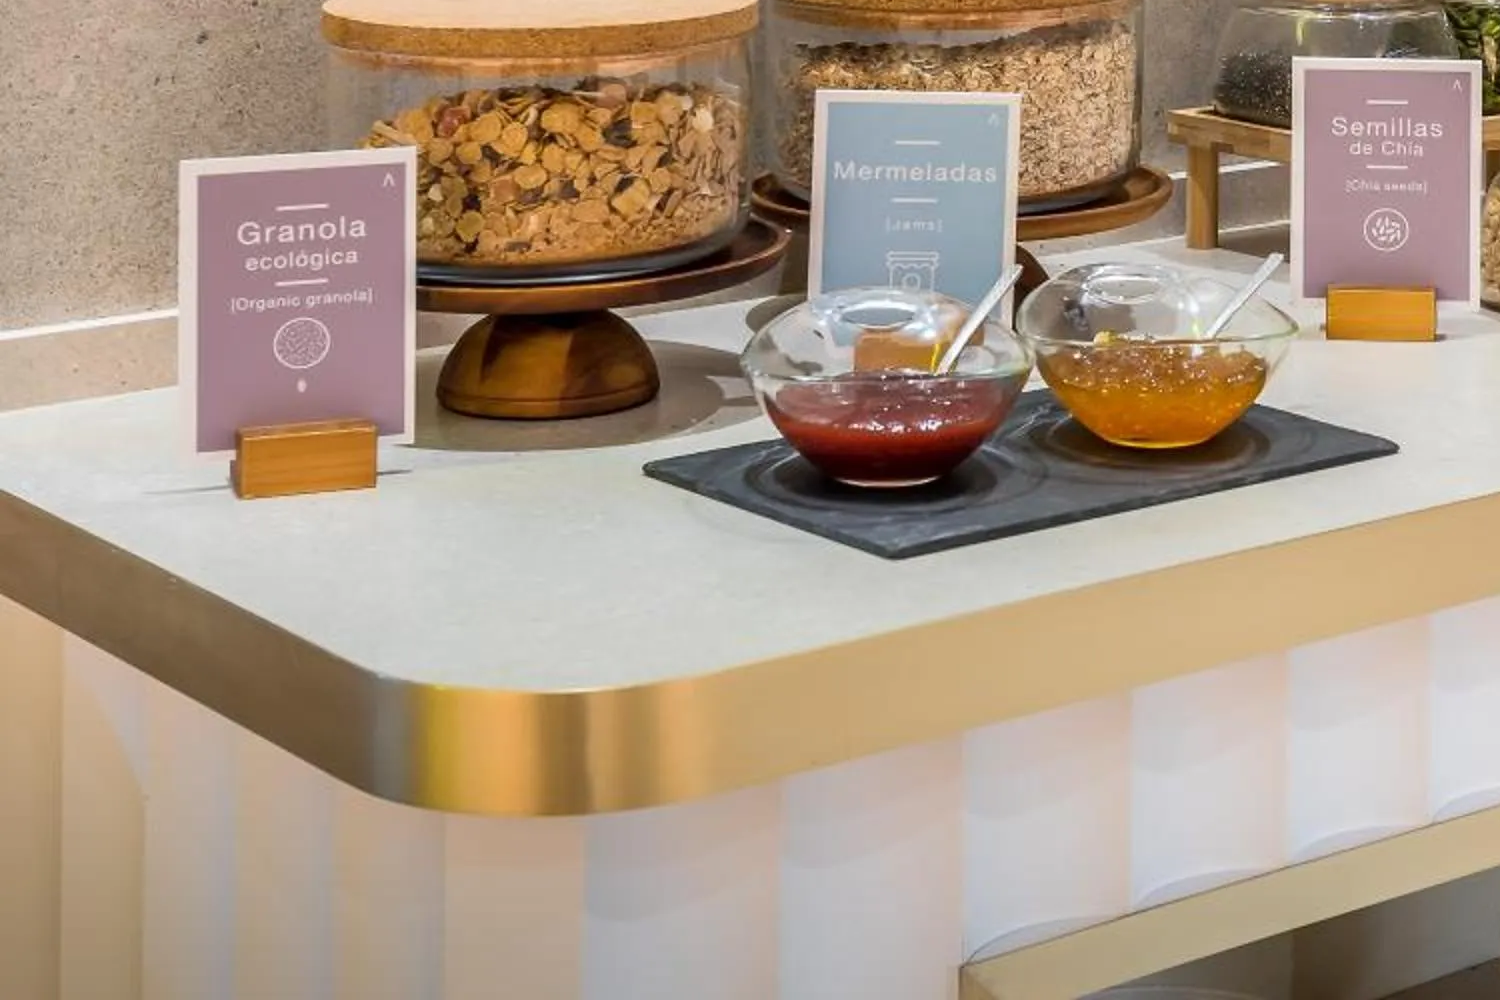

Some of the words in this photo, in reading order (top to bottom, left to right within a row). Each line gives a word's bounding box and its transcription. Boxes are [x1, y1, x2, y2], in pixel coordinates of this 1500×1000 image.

[1331, 117, 1444, 138] Semillas
[1349, 141, 1373, 155] de
[833, 161, 998, 183] Mermeladas
[237, 216, 367, 246] Granola
[245, 248, 358, 271] ecológica
